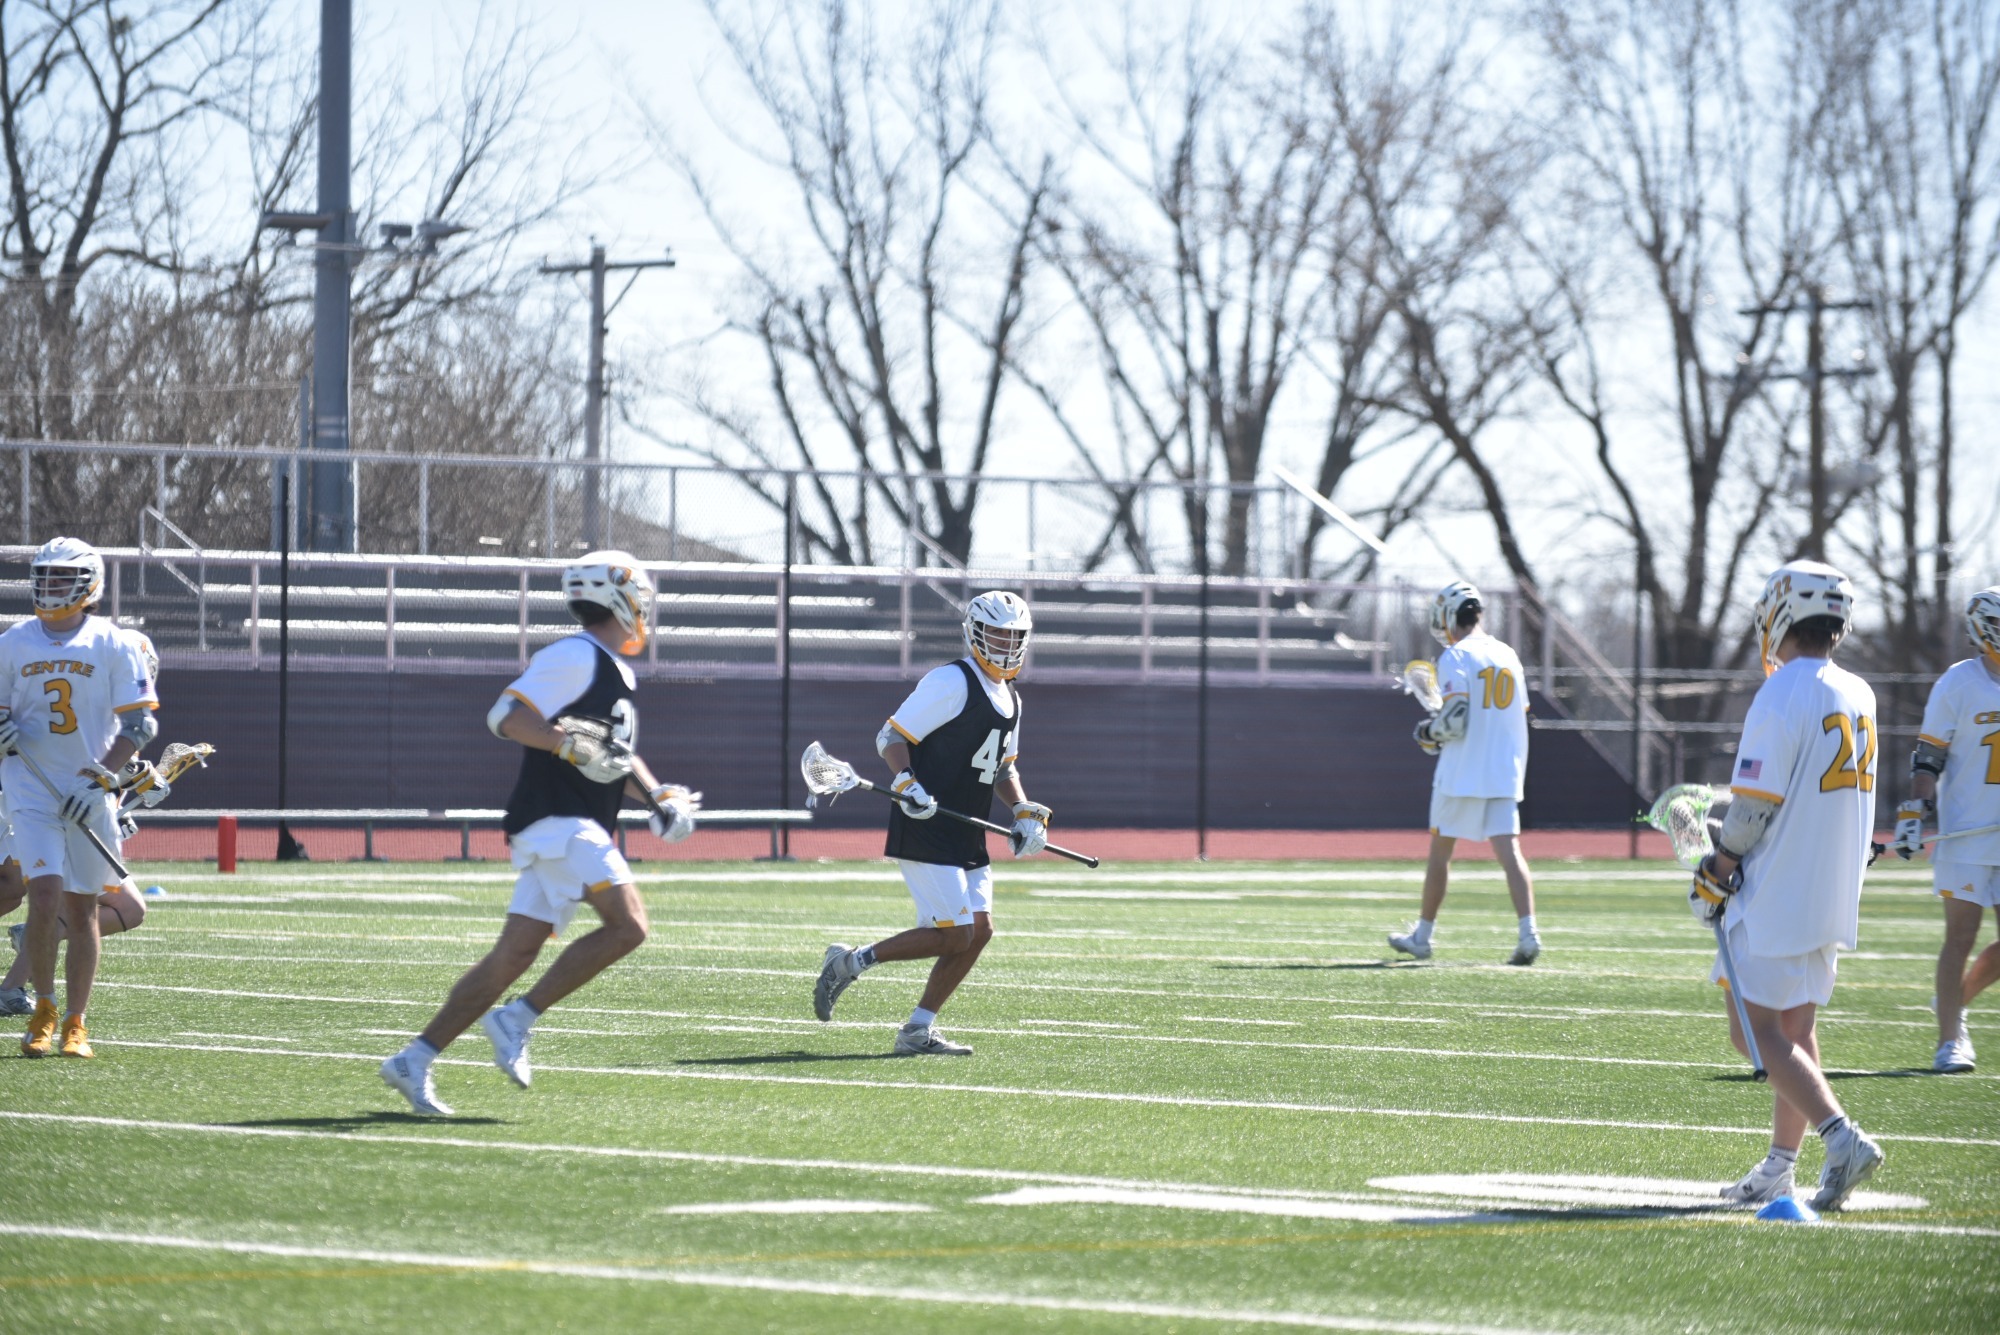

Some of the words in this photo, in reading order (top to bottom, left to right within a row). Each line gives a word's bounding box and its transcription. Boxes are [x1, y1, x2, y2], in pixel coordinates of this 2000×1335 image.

[21, 660, 95, 677] CENTRE
[1478, 667, 1514, 709] 10
[44, 678, 77, 735] 3
[1820, 712, 1876, 793] 22
